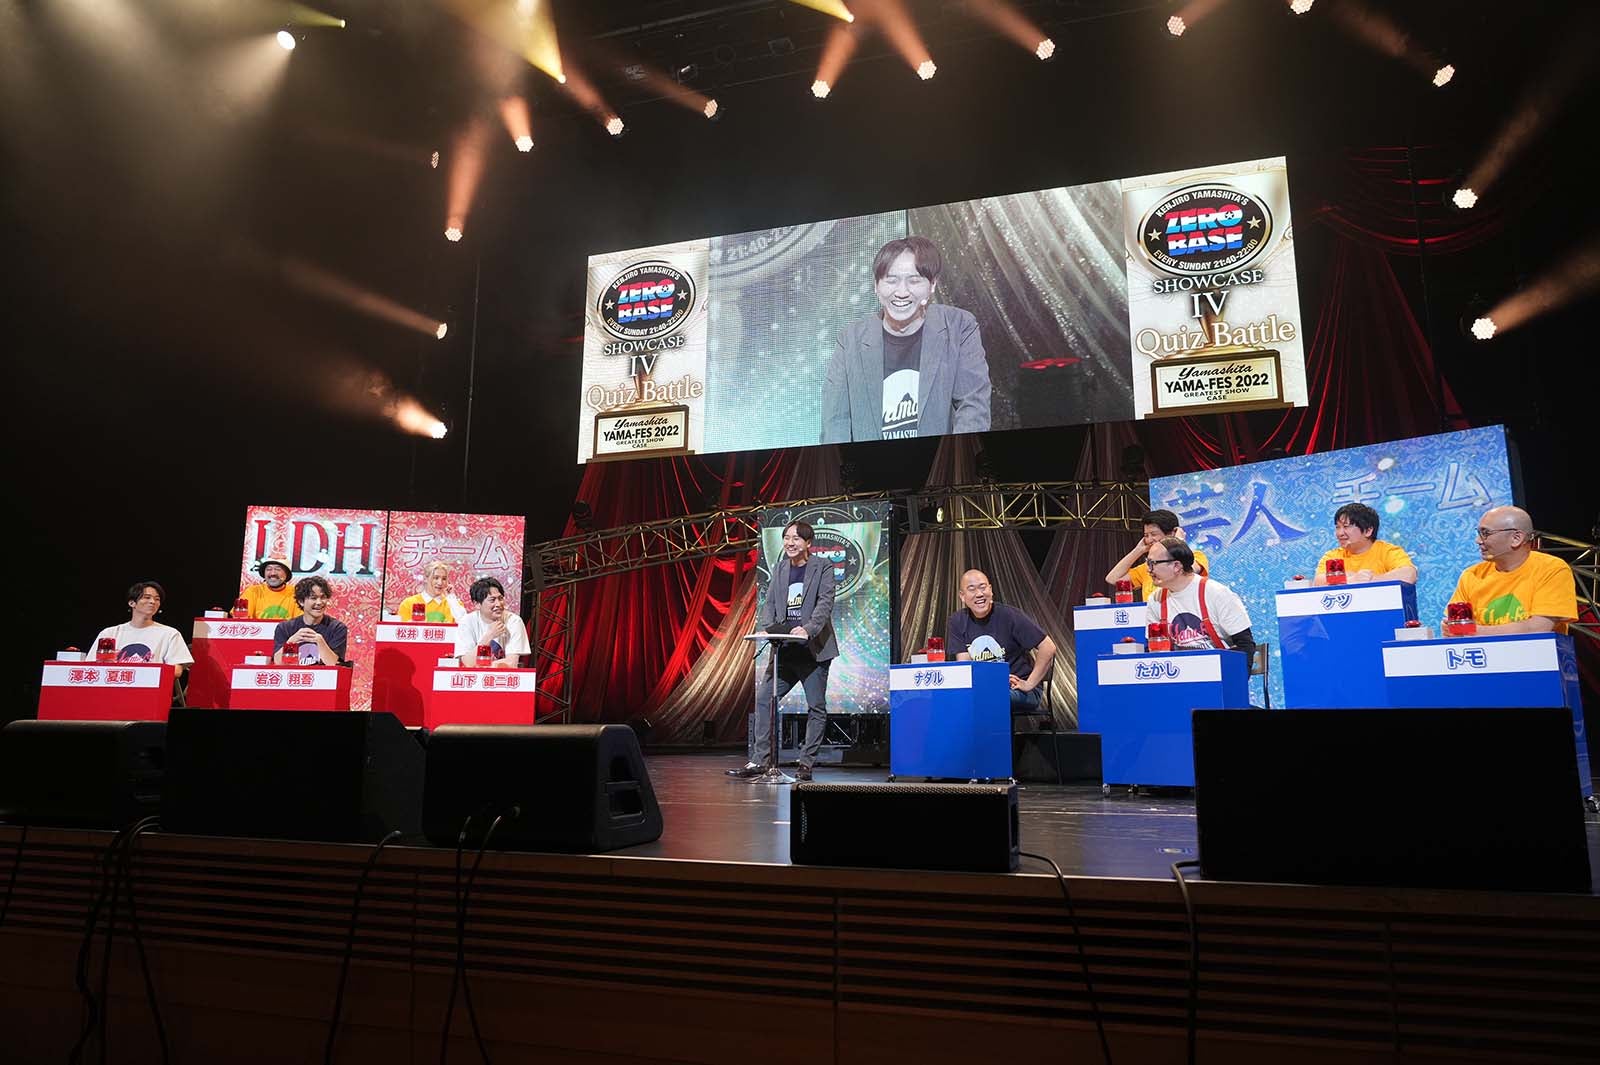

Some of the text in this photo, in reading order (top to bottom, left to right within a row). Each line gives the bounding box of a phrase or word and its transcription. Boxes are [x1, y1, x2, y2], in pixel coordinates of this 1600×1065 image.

[1155, 190, 1249, 217] KENJIRO YAMASHITA'S
[1164, 204, 1243, 234] ZERO
[1166, 225, 1244, 256] BASE
[1153, 249, 1178, 267] EVERY
[1178, 261, 1212, 270] SUNDAY
[612, 266, 681, 290] KENJIRO YAMASHITA'S
[1153, 269, 1265, 294] SHOWCASE
[617, 278, 676, 304] ZERO
[617, 297, 675, 323] BASE
[1191, 290, 1230, 318] IV
[607, 317, 625, 333] EVERY
[624, 327, 648, 336] SUNDAY
[603, 335, 685, 355] SHOWCASE
[1136, 314, 1296, 361] Quiz Battle
[630, 353, 658, 377] IV
[1178, 363, 1254, 380] Yamashita
[1165, 373, 1269, 393] YAMA-FES 2022
[1183, 387, 1250, 398] GREATEST SHOW
[587, 375, 703, 412] Quiz Battle
[613, 416, 669, 430] Yamashita
[603, 425, 679, 442] YAMA-FES 2022
[1331, 462, 1493, 511] チーム
[401, 533, 510, 571] チーム
[1321, 594, 1351, 609] ケツ
[1115, 610, 1128, 624] 辻
[396, 628, 418, 640] 松井
[1446, 649, 1485, 668] トモ
[256, 673, 314, 687] 岩谷 翔吾
[914, 671, 944, 686] ナダル
[1136, 662, 1179, 679] たかし
[451, 674, 520, 688] 山下 健二郎
